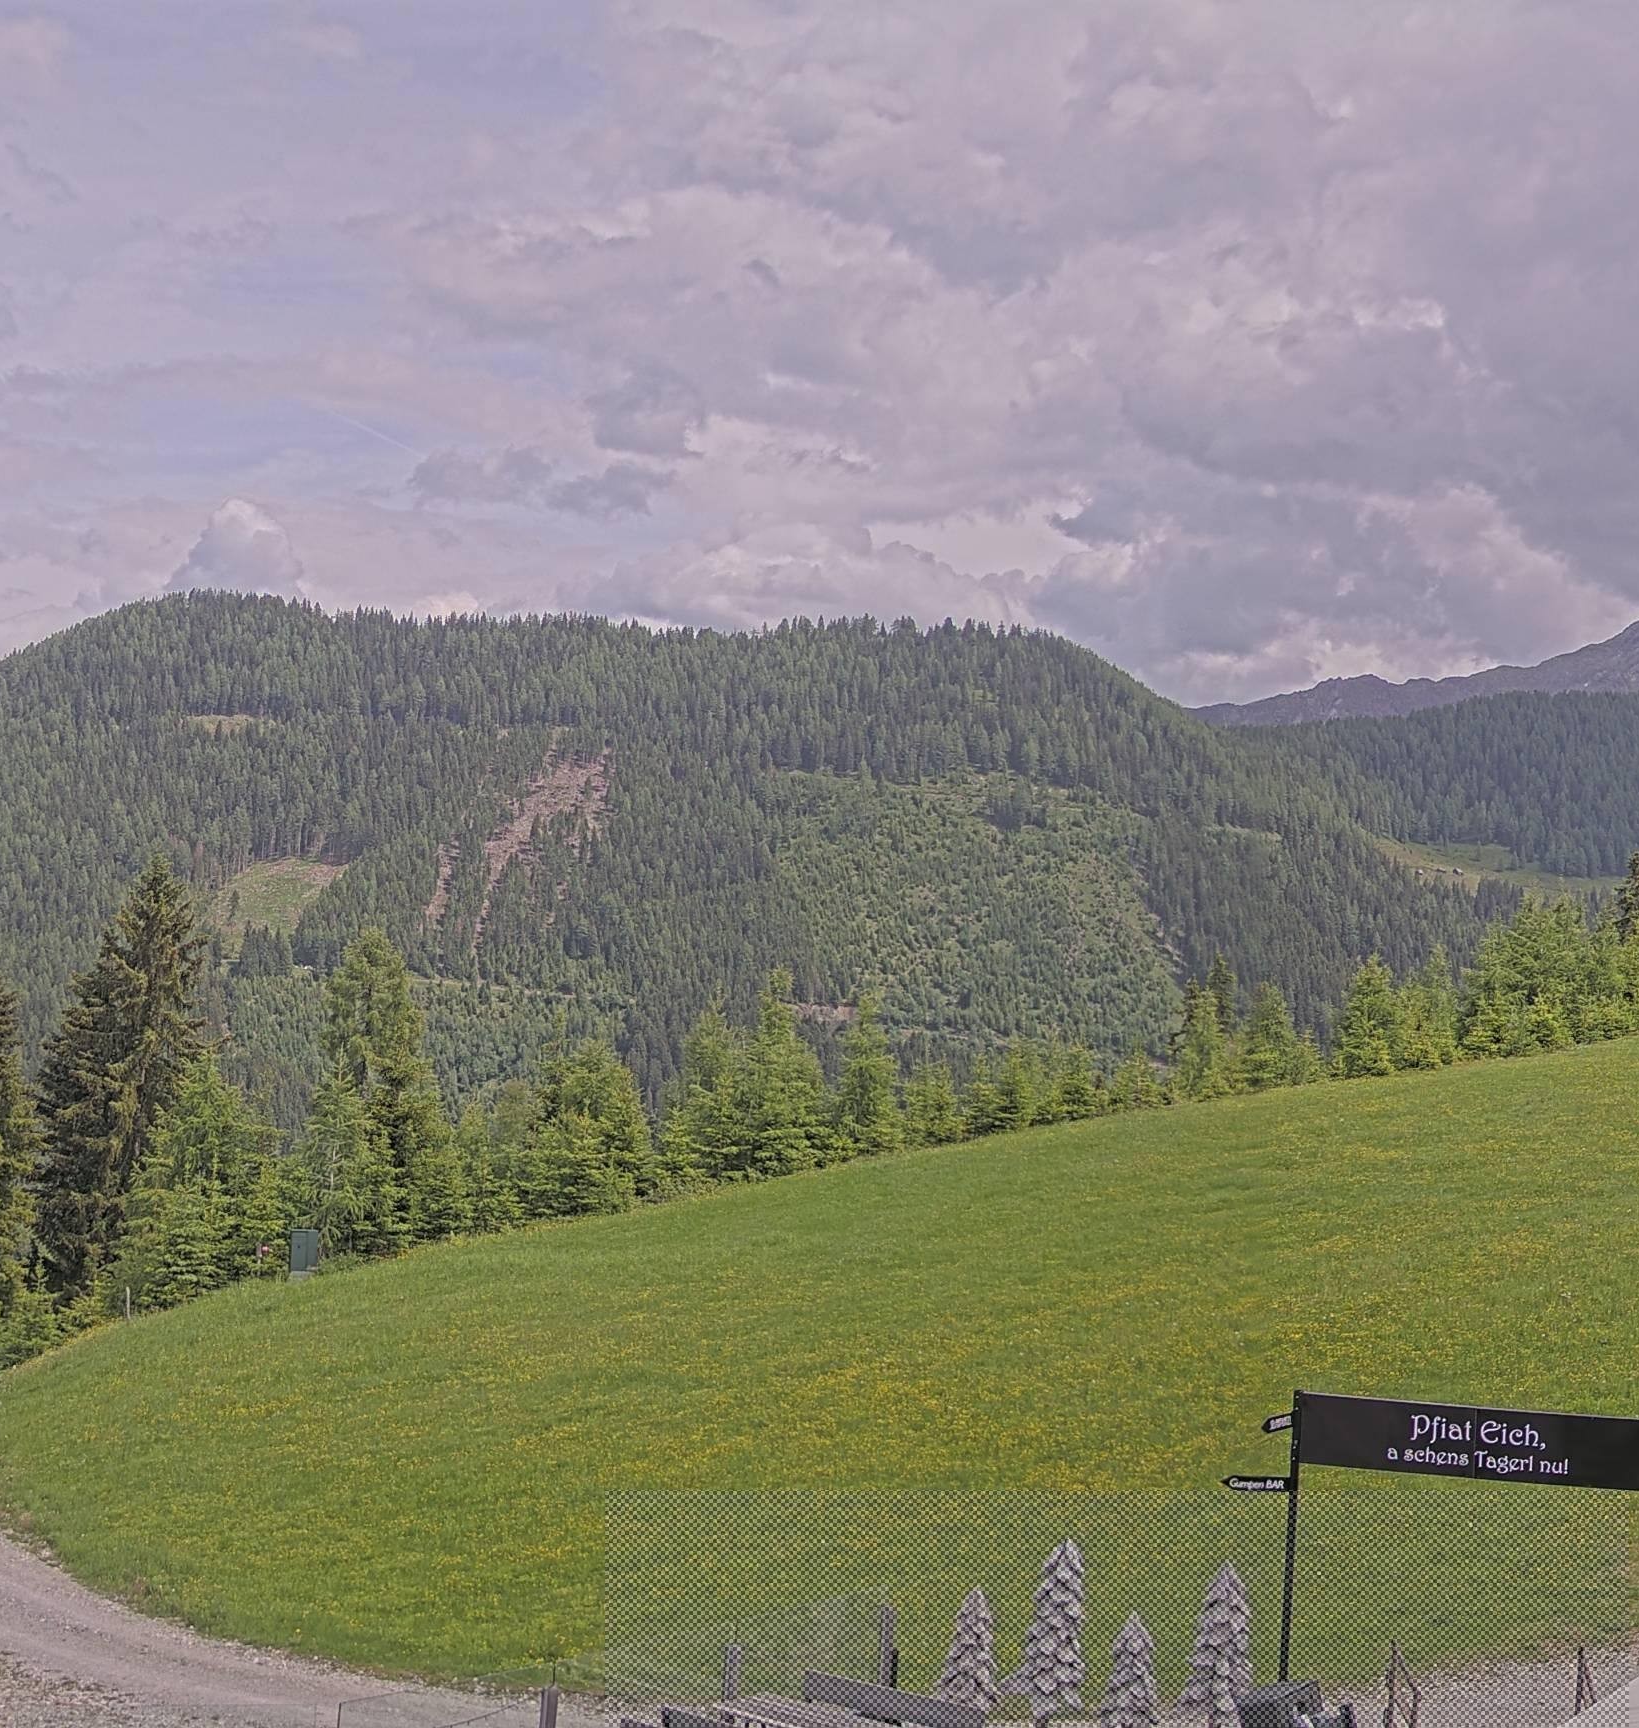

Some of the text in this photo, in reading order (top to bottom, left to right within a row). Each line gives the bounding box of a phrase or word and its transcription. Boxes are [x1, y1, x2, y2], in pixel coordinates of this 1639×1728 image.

[1410, 1414, 1547, 1450] Pfiat Eich,
[1387, 1447, 1569, 1475] a schens Tagerl nu!
[1229, 1477, 1285, 1490] Gumpen BAR
